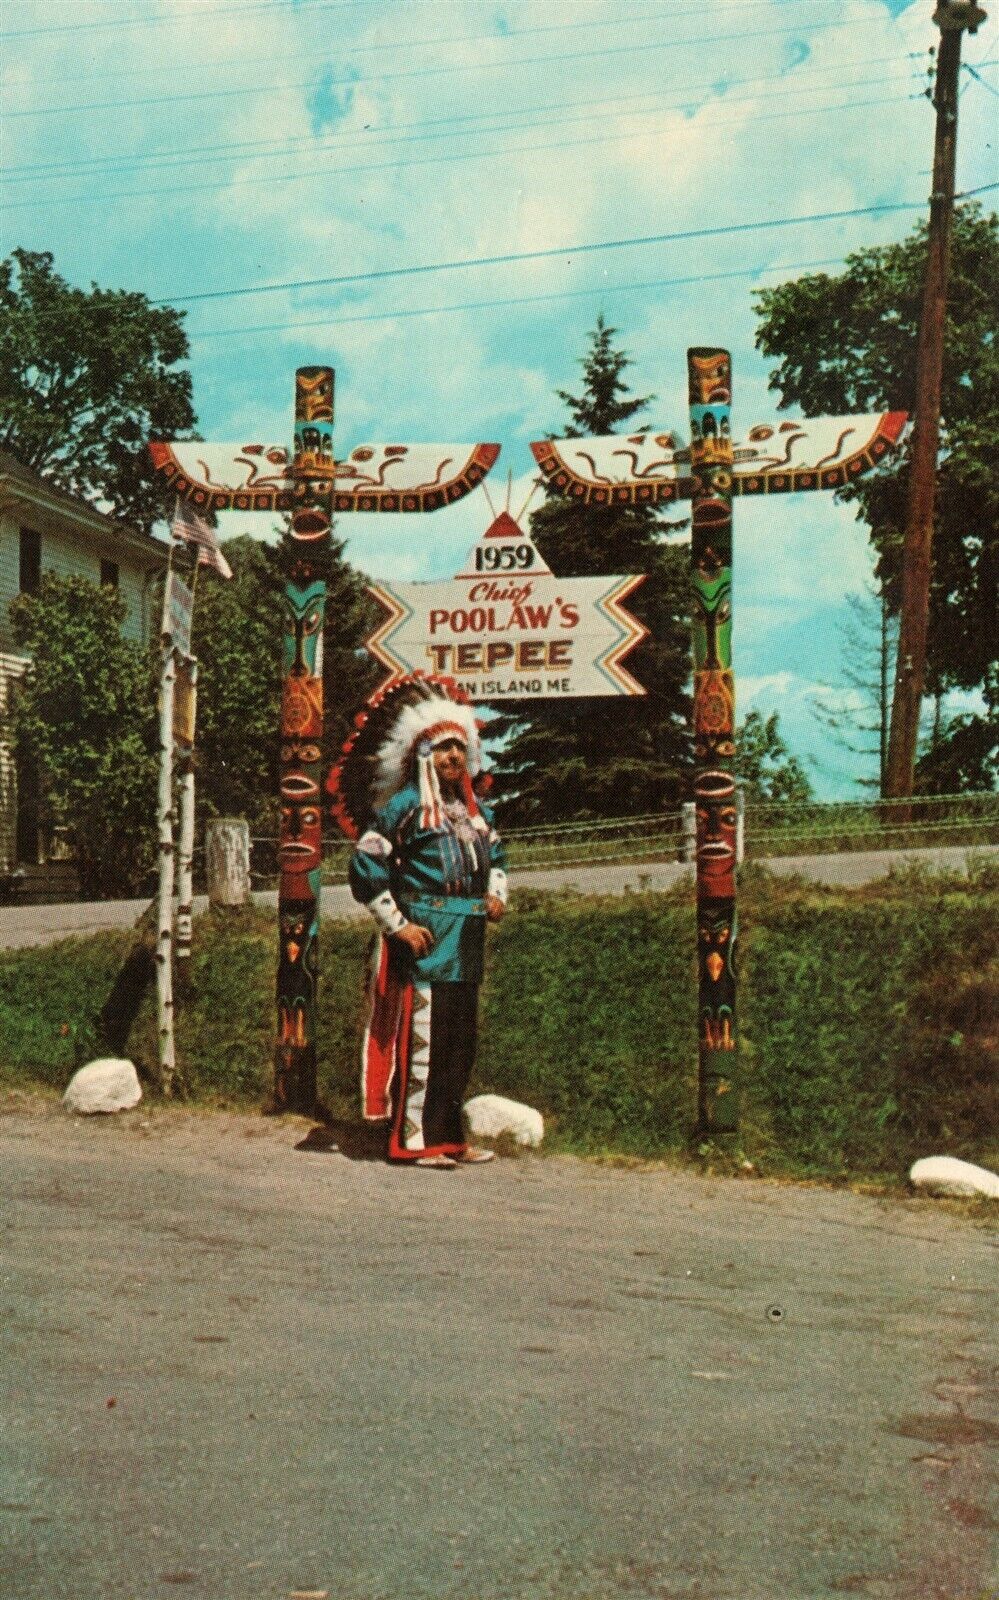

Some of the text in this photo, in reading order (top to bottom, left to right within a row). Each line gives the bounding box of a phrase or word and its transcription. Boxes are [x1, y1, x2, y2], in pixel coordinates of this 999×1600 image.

[475, 545, 535, 571] 1959
[468, 581, 533, 606] Chief
[429, 597, 580, 634] POOLAW'S
[426, 639, 573, 674] TEPEE
[482, 679, 542, 694] ISLAND
